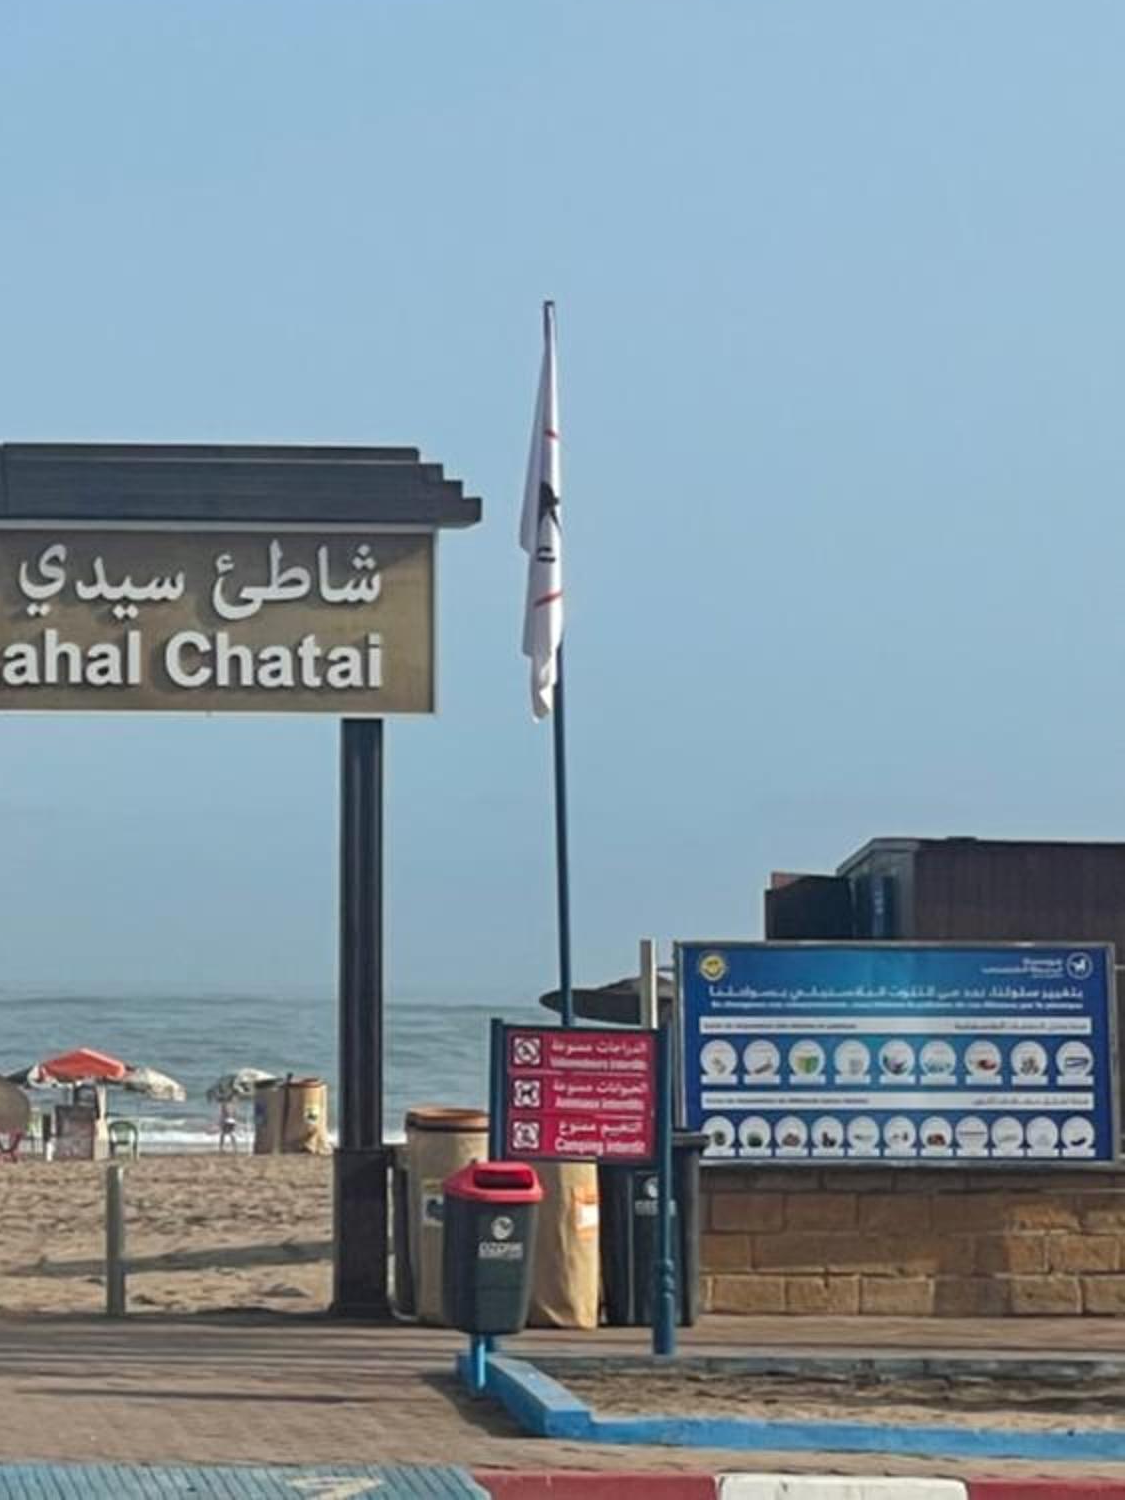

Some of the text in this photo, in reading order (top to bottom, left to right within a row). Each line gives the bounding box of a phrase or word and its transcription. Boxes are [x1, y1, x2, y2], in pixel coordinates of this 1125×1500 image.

[19, 543, 186, 619] سيدي
[212, 539, 382, 620] شاطئ
[165, 630, 383, 688] Chatai
